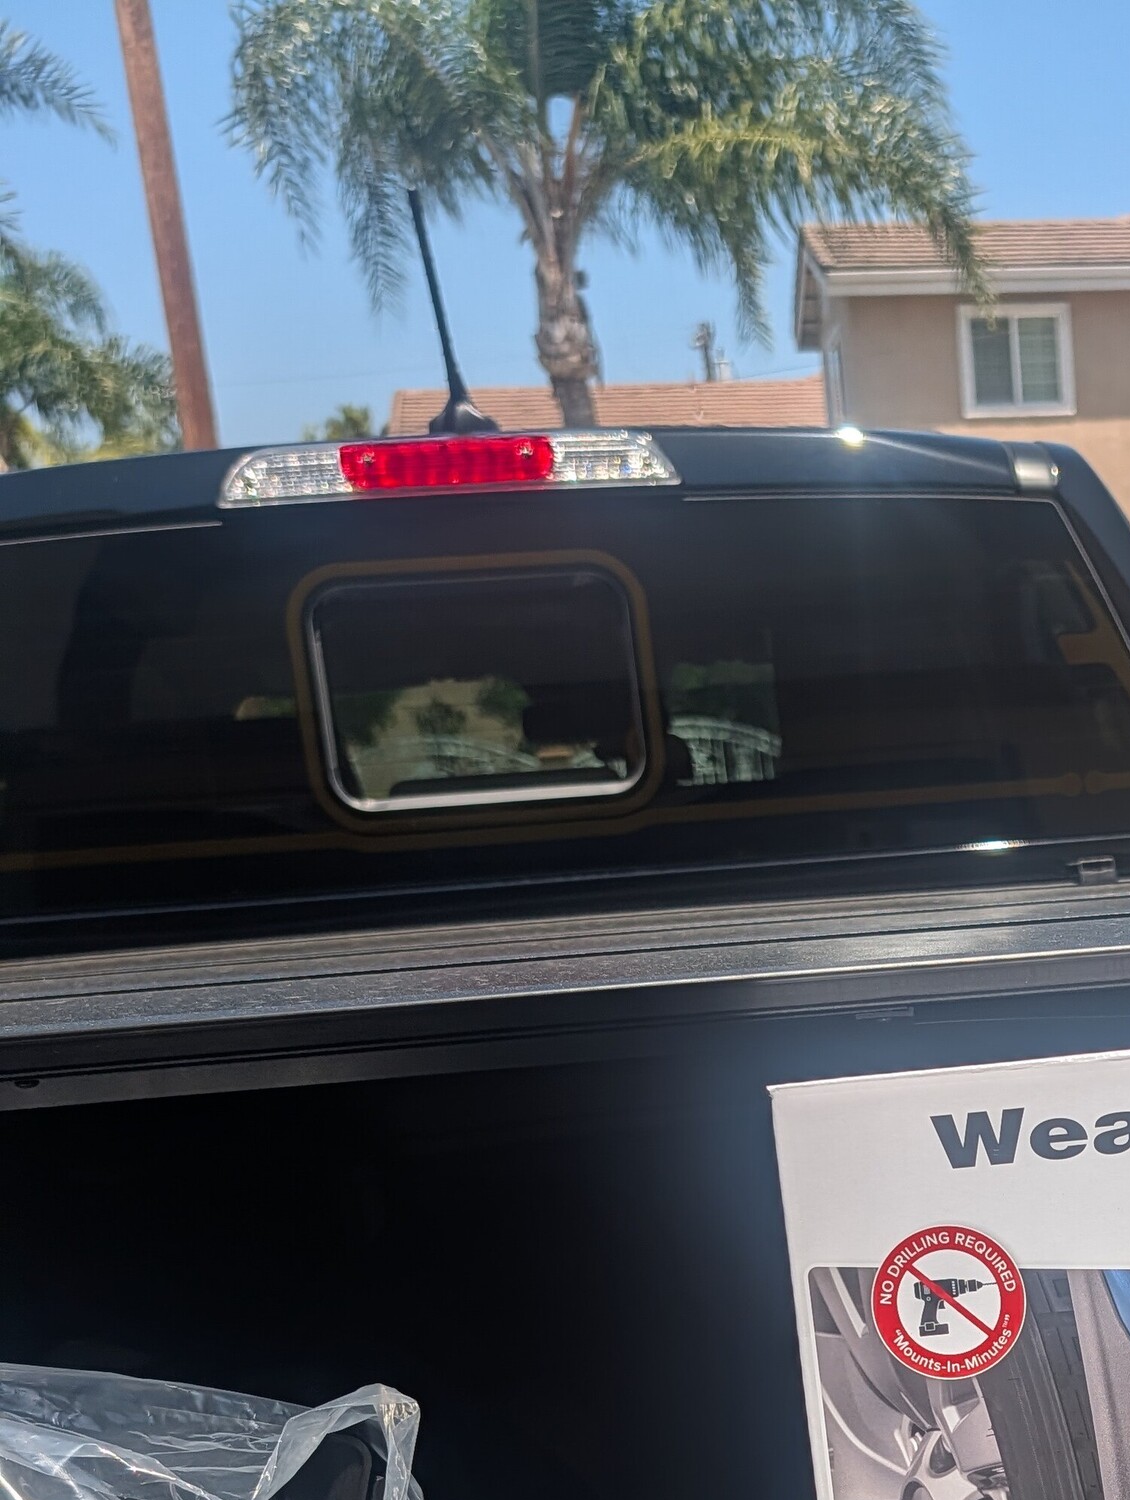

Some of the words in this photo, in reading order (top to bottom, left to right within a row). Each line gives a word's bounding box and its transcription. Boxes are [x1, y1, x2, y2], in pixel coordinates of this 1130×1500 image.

[880, 1282, 894, 1305] NO
[887, 1232, 950, 1279] DRILLING
[955, 1232, 1016, 1292] REQUIRED
